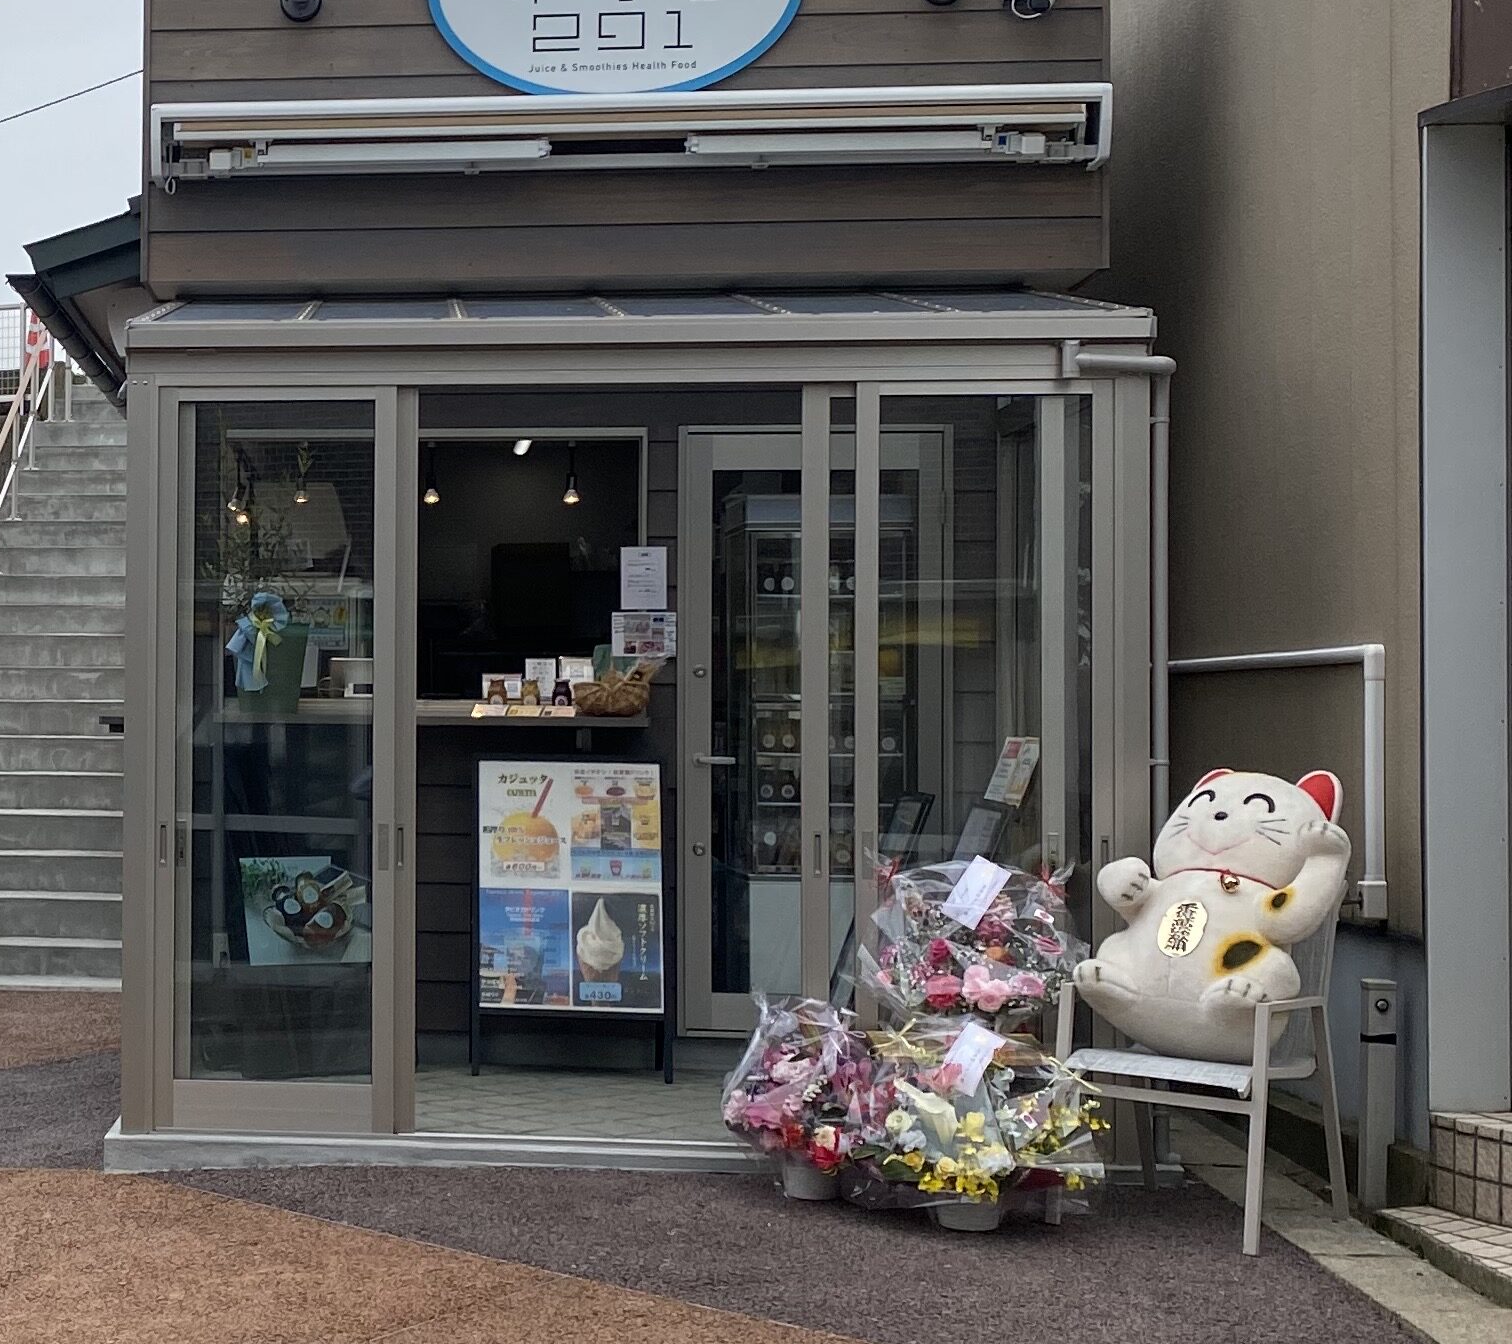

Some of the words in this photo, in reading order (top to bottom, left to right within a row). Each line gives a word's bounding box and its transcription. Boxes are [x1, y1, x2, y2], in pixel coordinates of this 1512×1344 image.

[532, 10, 693, 53] 291
[528, 63, 556, 73] Juice
[560, 63, 568, 72] &
[572, 62, 628, 72] Smoothies
[632, 61, 667, 70] Health
[671, 60, 697, 69] Food
